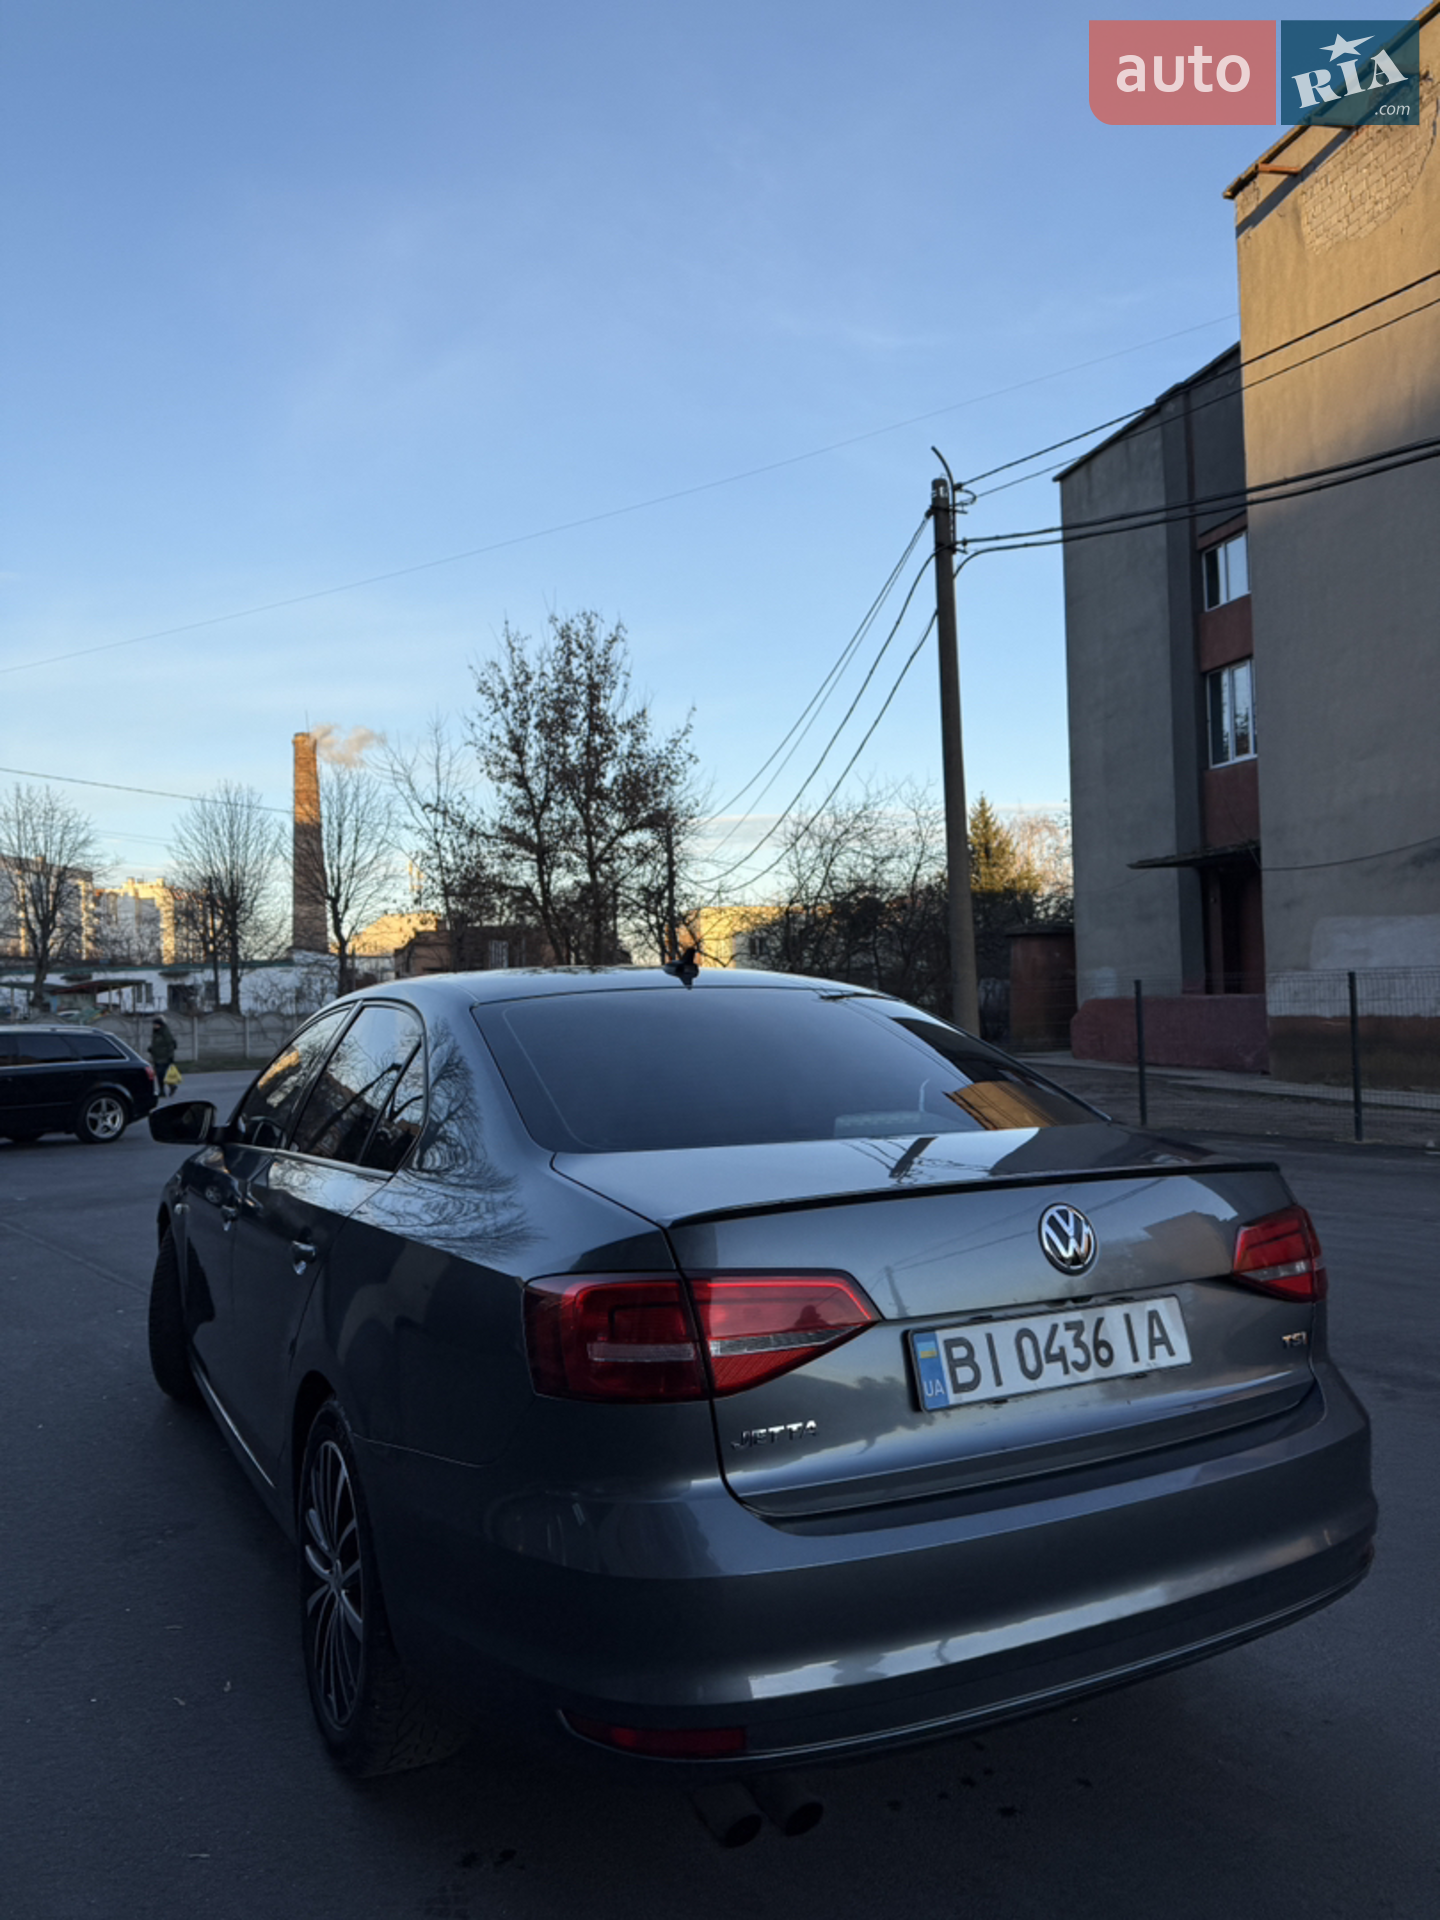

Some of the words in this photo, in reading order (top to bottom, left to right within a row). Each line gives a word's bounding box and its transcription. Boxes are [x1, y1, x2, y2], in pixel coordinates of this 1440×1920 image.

[943, 1332, 1003, 1394] BI
[1014, 1317, 1114, 1380] 0436
[1123, 1309, 1176, 1363] IA
[922, 1379, 946, 1397] UA
[730, 1420, 817, 1450] JETTA
